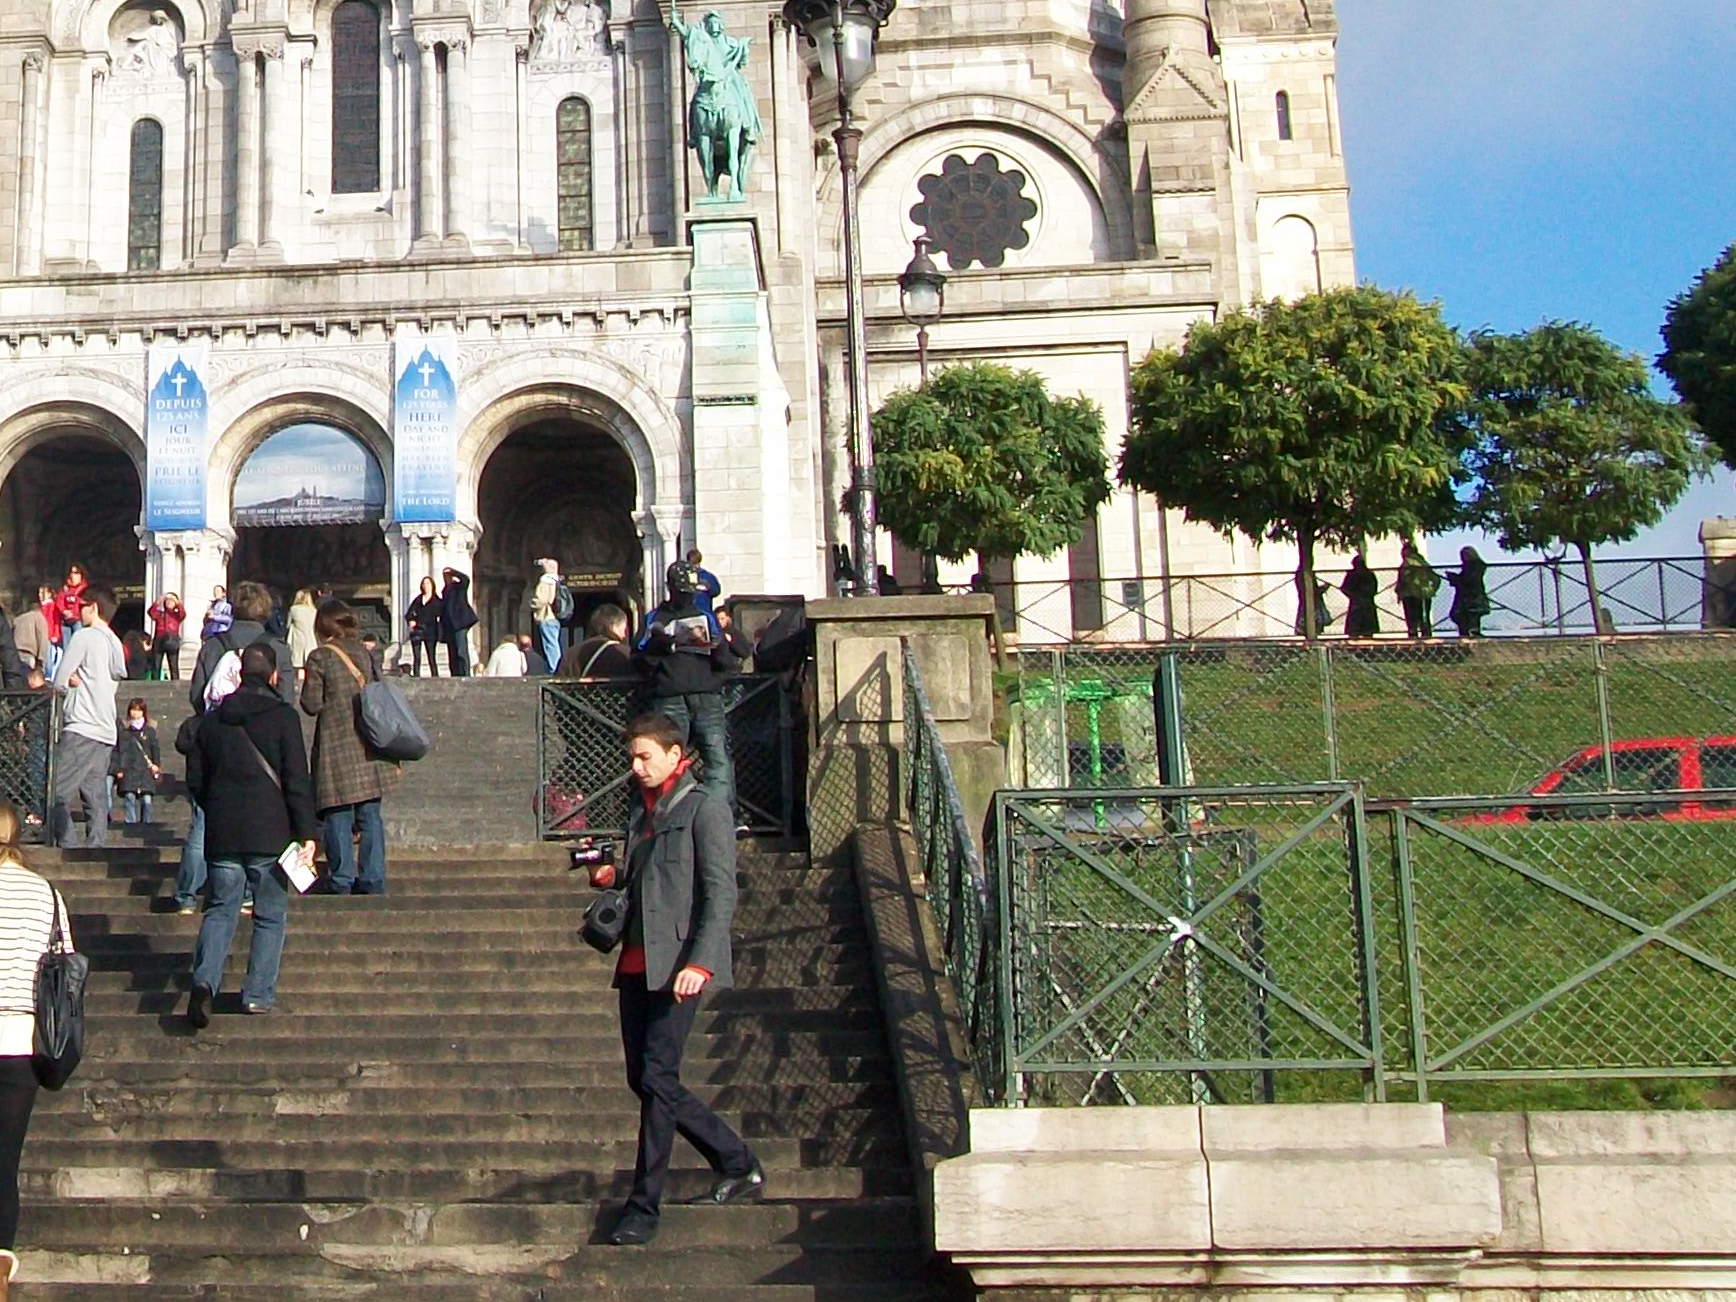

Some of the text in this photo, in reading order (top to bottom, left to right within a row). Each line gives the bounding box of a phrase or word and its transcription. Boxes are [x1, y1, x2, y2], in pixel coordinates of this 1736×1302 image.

[414, 388, 440, 399] FOR
[155, 398, 202, 410] DEPUIS
[175, 411, 200, 421] ANS
[409, 412, 441, 422] HERE
[169, 424, 188, 434] ICI
[403, 425, 449, 433] DAY AND
[165, 437, 191, 446] JOUR
[172, 447, 196, 455] NUIT
[154, 466, 201, 476] PRIE LE
[403, 496, 450, 506] THE LORD
